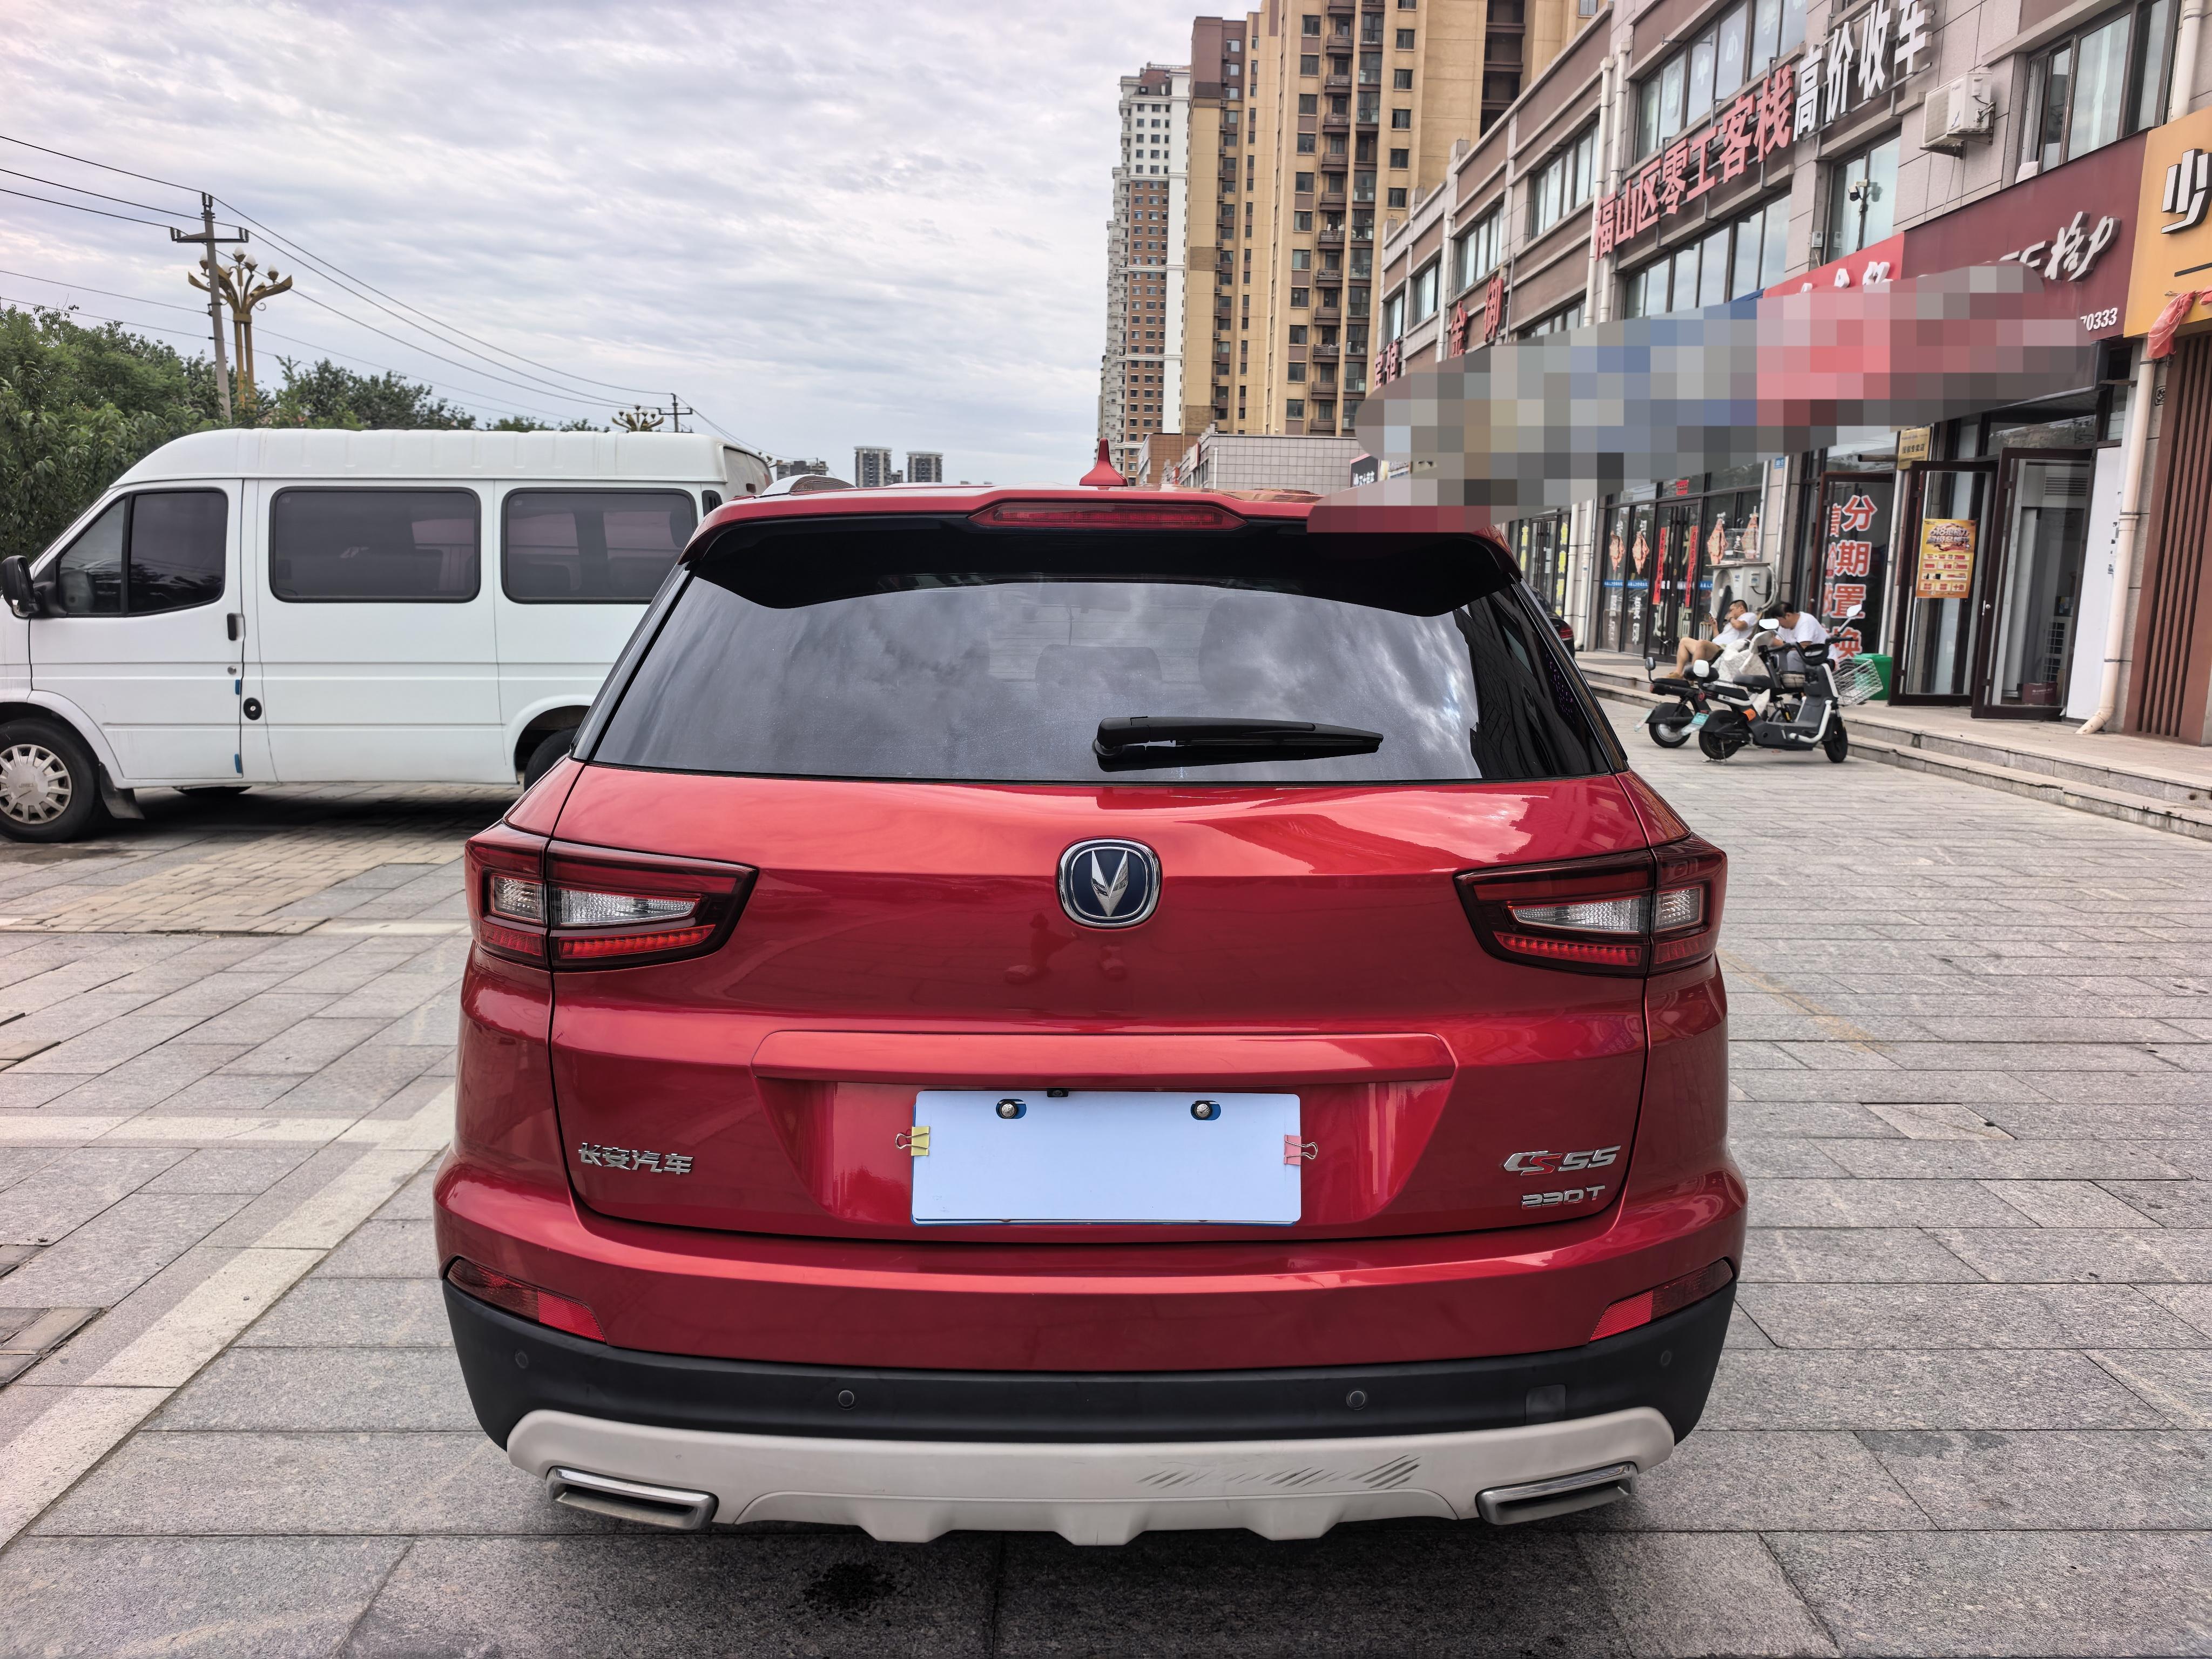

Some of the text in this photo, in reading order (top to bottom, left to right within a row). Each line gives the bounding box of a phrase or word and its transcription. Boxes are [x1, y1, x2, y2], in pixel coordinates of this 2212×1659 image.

[1792, 0, 1930, 141] 高价收车
[1594, 64, 1794, 261] 福山区零工客栈
[1830, 495, 1878, 660] 分期置换
[578, 1143, 693, 1175] 长安汽车
[1504, 1145, 1621, 1176] CS55
